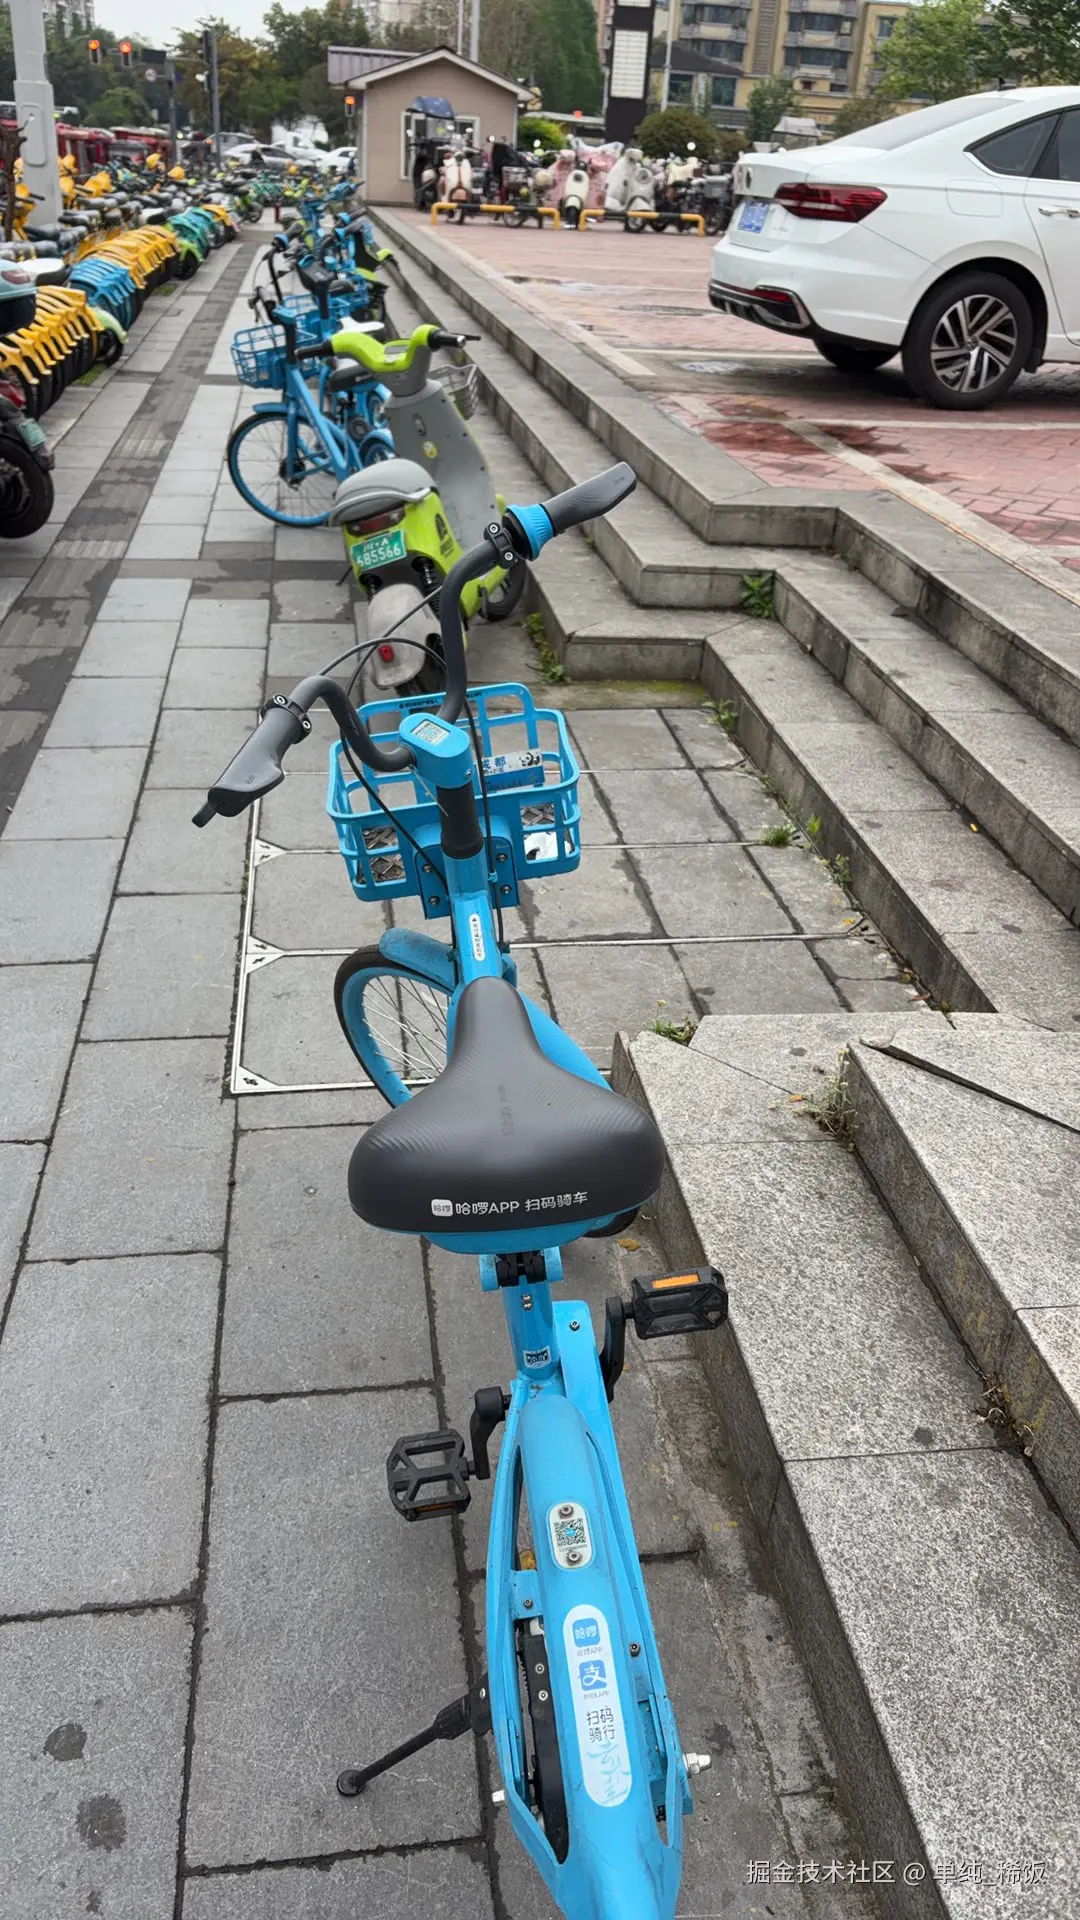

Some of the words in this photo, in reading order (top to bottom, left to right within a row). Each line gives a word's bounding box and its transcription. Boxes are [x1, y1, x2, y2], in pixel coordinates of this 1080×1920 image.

[455, 1202, 520, 1216] 哈啰APP
[524, 1191, 589, 1212] 扫码骑车
[586, 1707, 614, 1726] 扫码
[588, 1724, 616, 1743] 骑行
